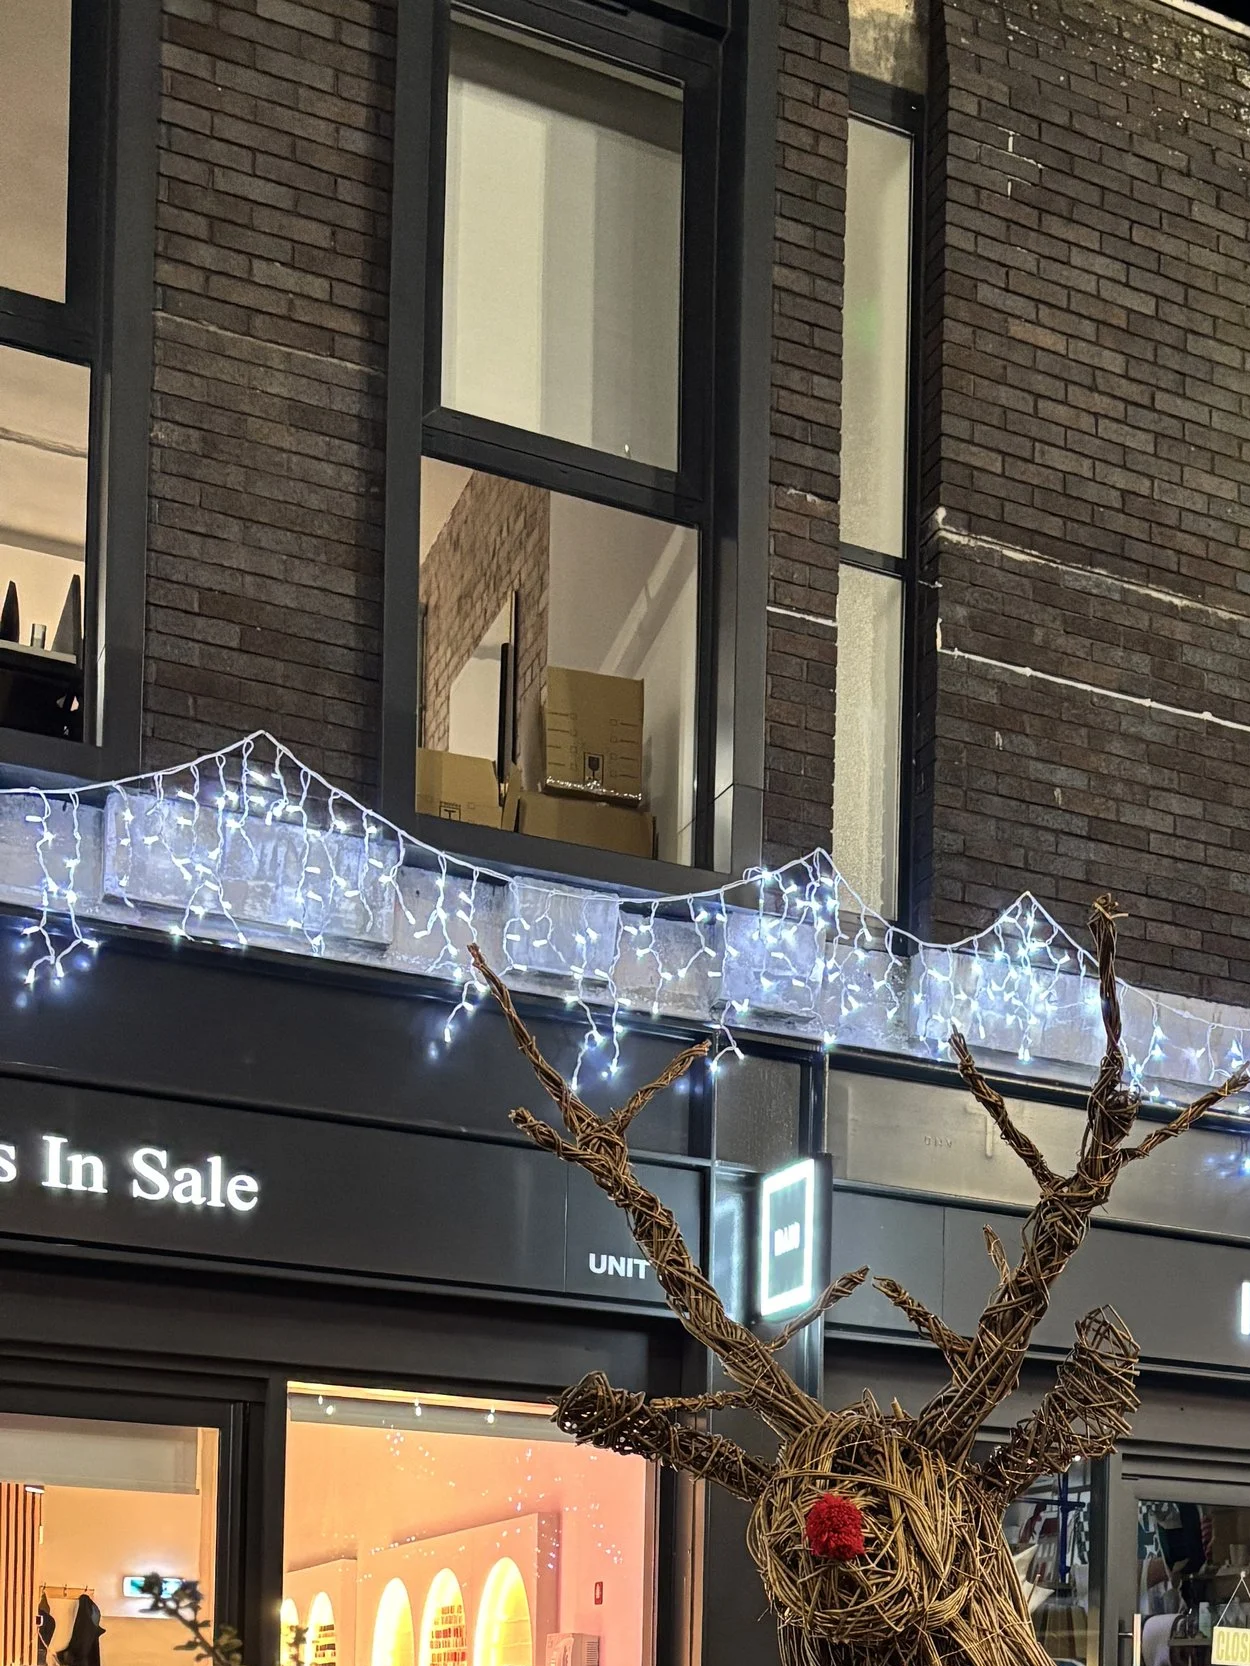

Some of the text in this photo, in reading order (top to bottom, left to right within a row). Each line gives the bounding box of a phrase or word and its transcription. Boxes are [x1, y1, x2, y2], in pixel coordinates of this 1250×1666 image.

[42, 1135, 108, 1193] In
[132, 1147, 259, 1211] Sale
[588, 1253, 651, 1279] UNIT
